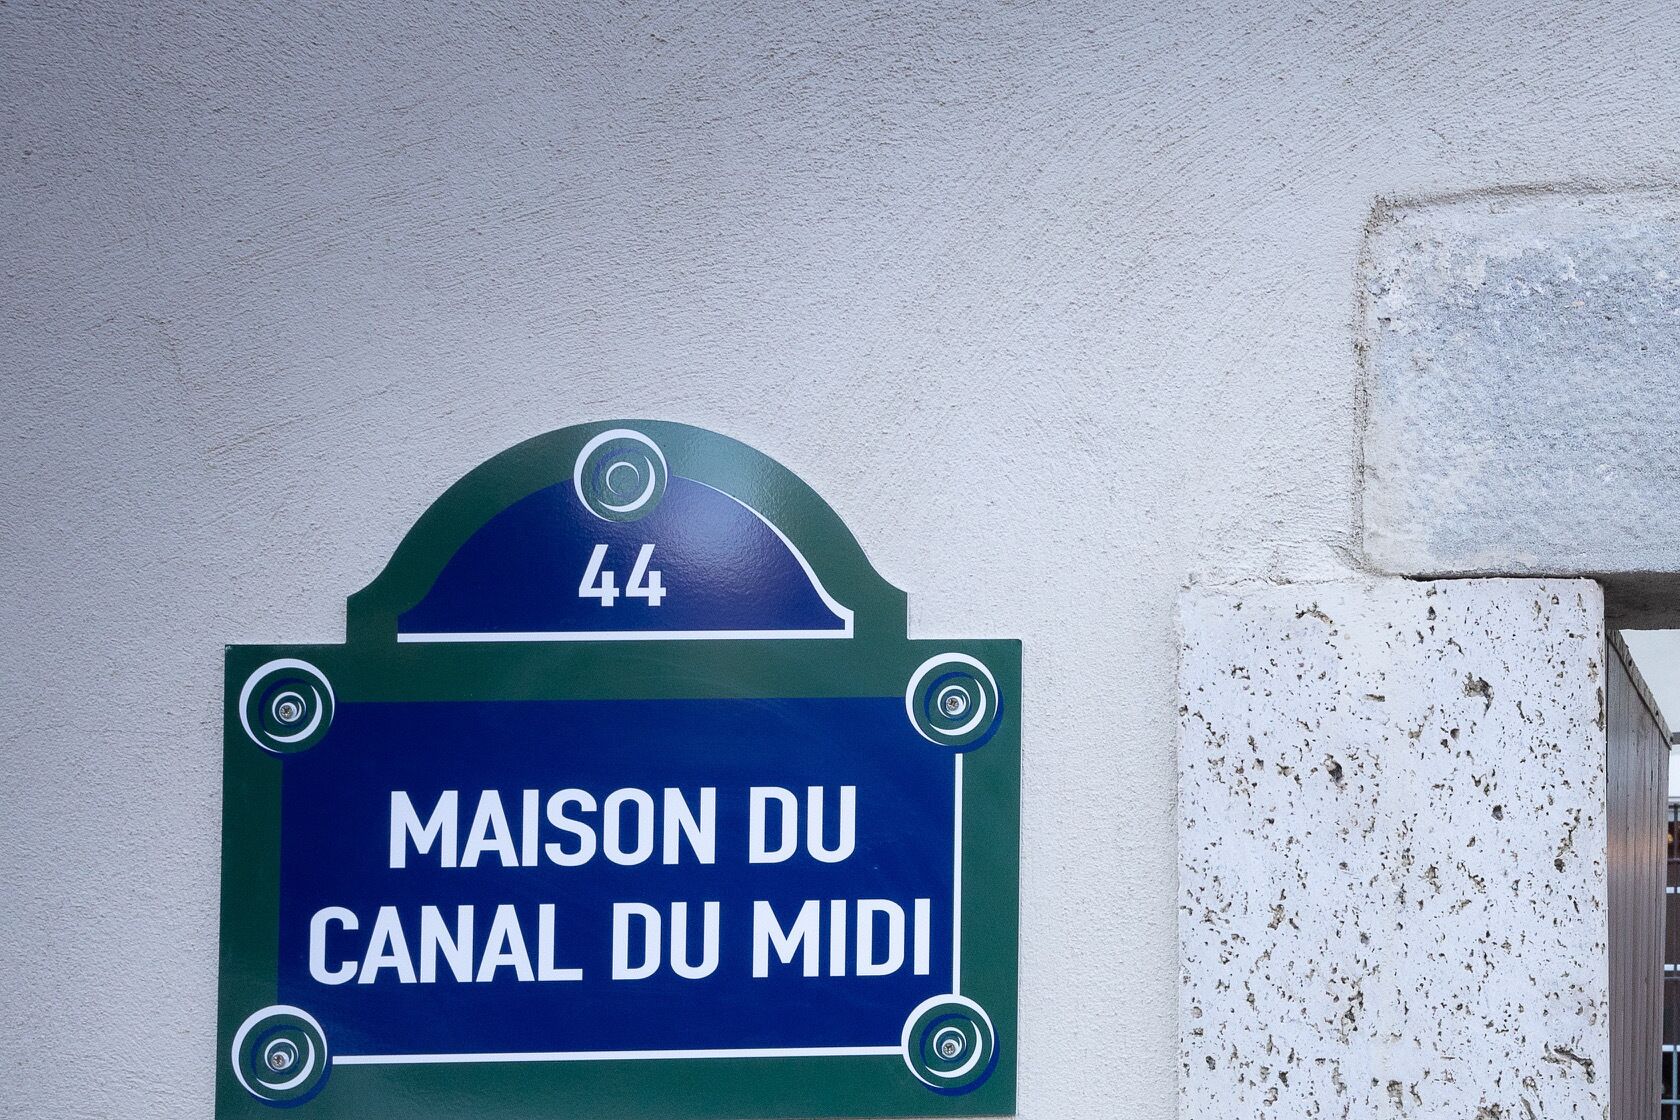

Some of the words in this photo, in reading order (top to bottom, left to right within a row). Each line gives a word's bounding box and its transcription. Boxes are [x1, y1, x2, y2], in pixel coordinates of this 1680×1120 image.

[578, 544, 667, 607] 44
[389, 787, 717, 868] MAISON
[748, 785, 856, 865] DU
[309, 903, 583, 985] CANAL
[612, 901, 720, 980] DU
[752, 898, 931, 978] MIDI
